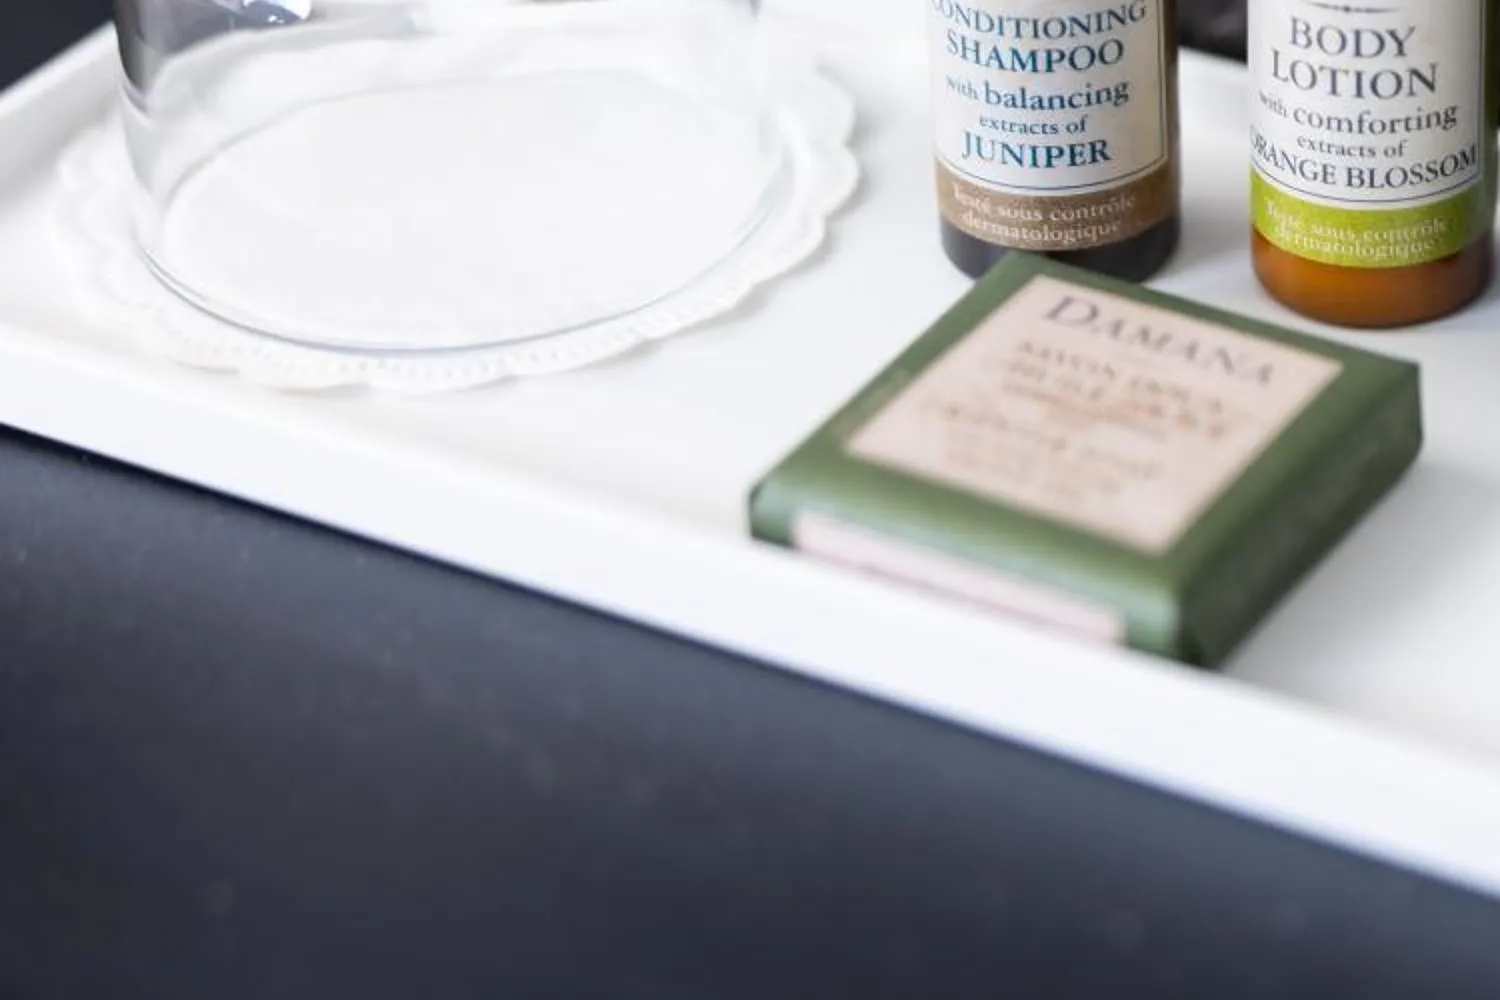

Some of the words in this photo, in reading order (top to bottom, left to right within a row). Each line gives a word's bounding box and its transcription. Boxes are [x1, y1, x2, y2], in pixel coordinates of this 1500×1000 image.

[946, 30, 1124, 74] SHAMPOO
[1290, 16, 1415, 58] BODY
[946, 75, 979, 101] with
[984, 80, 1130, 112] balancing
[1272, 50, 1438, 100] LOTION
[979, 114, 1059, 136] extracts
[1066, 114, 1089, 135] of
[1258, 89, 1288, 118] with
[1294, 104, 1458, 136] comforting
[962, 131, 1111, 169] JUNIPER
[1297, 136, 1377, 158] extracts
[1384, 138, 1408, 158] of
[1346, 143, 1477, 189] BLOSSOM
[962, 211, 1122, 244] dermatologique
[1000, 204, 1043, 222] sous
[1040, 294, 1278, 387] DAMANA
